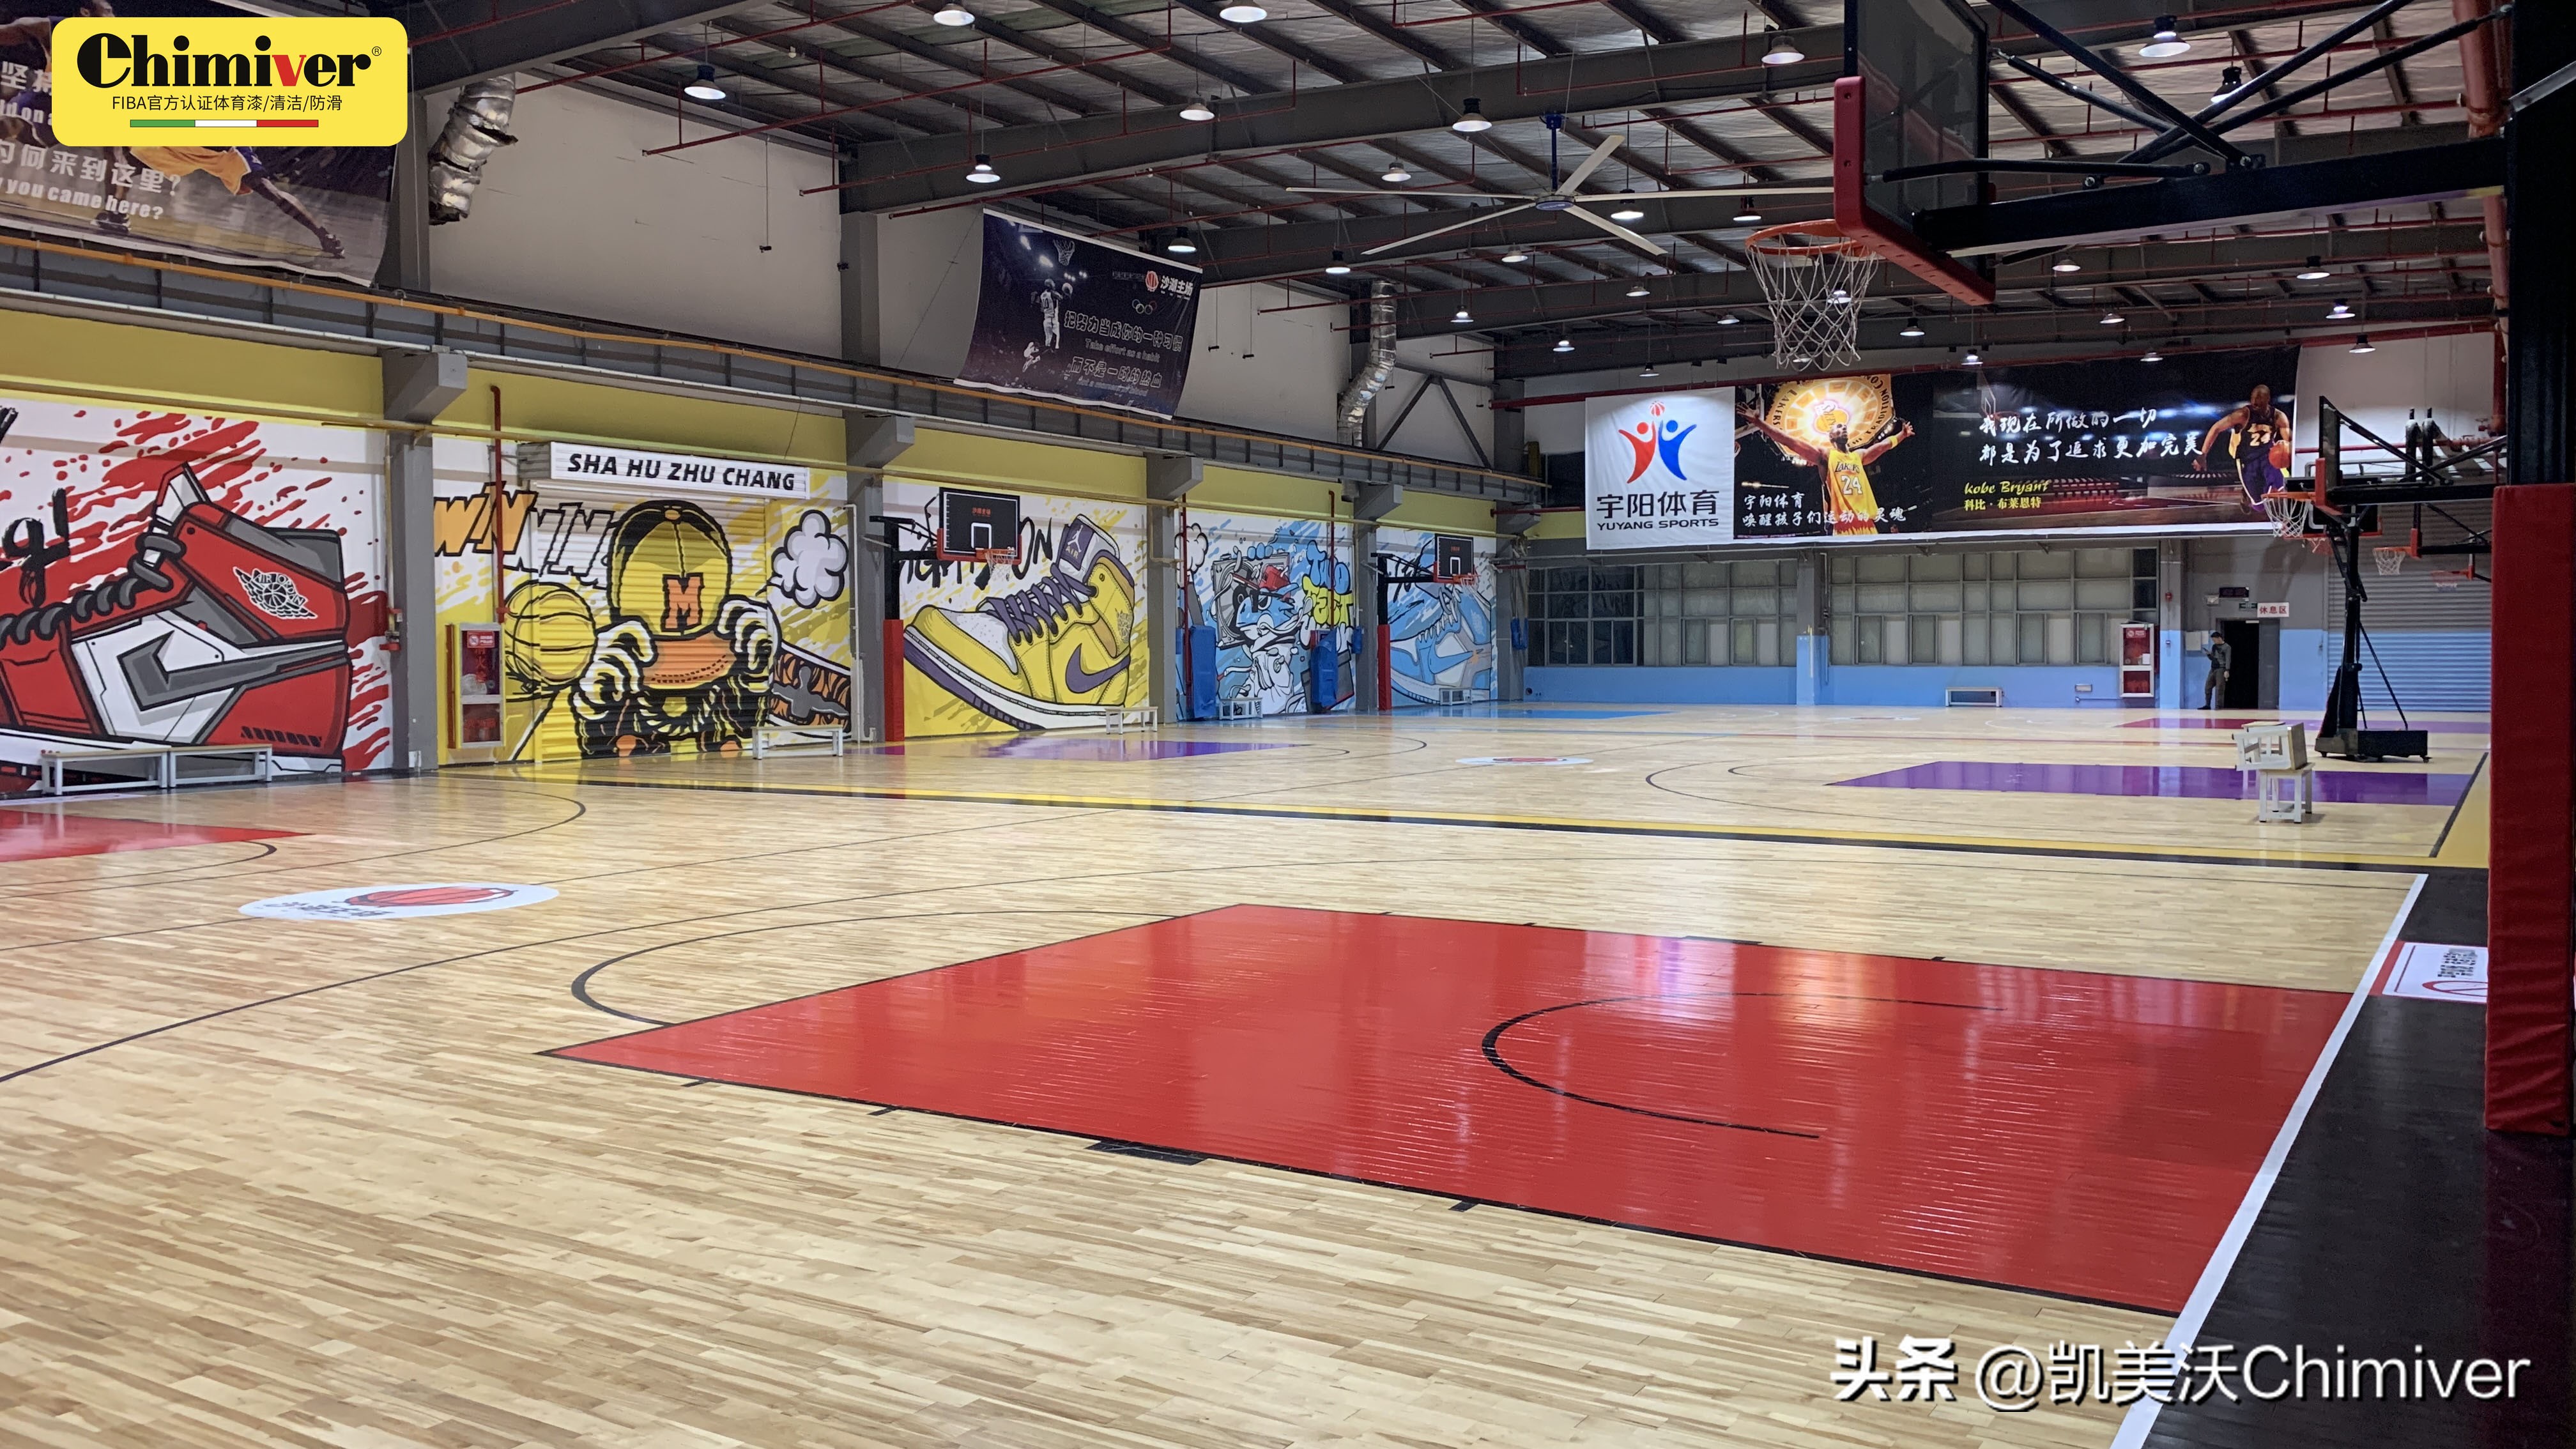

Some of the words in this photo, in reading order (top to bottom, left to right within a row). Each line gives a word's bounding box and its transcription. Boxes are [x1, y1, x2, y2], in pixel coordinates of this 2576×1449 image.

[5, 179, 43, 198] you
[47, 186, 102, 208] came
[105, 195, 164, 220] here?
[1979, 407, 2158, 437] 我现在所做的一切
[1979, 431, 2203, 466] 都是为了追求更加完美
[567, 453, 617, 475] SHA
[626, 459, 661, 479] HU
[666, 463, 716, 483] ZHU
[723, 468, 795, 491] CHANG
[1841, 475, 1863, 494] 24
[1999, 479, 2052, 495] Bryant
[1597, 489, 1720, 519] 宇阳体育
[1744, 492, 1805, 510] 宇阳体育
[1597, 521, 1653, 531] YUYANG
[1659, 518, 1719, 528] SPORTS
[1742, 507, 1906, 527] 唤醒孩子们运动的灵魂
[1066, 546, 1078, 559] AIR
[661, 572, 705, 632] M
[2259, 606, 2287, 615] 休息区
